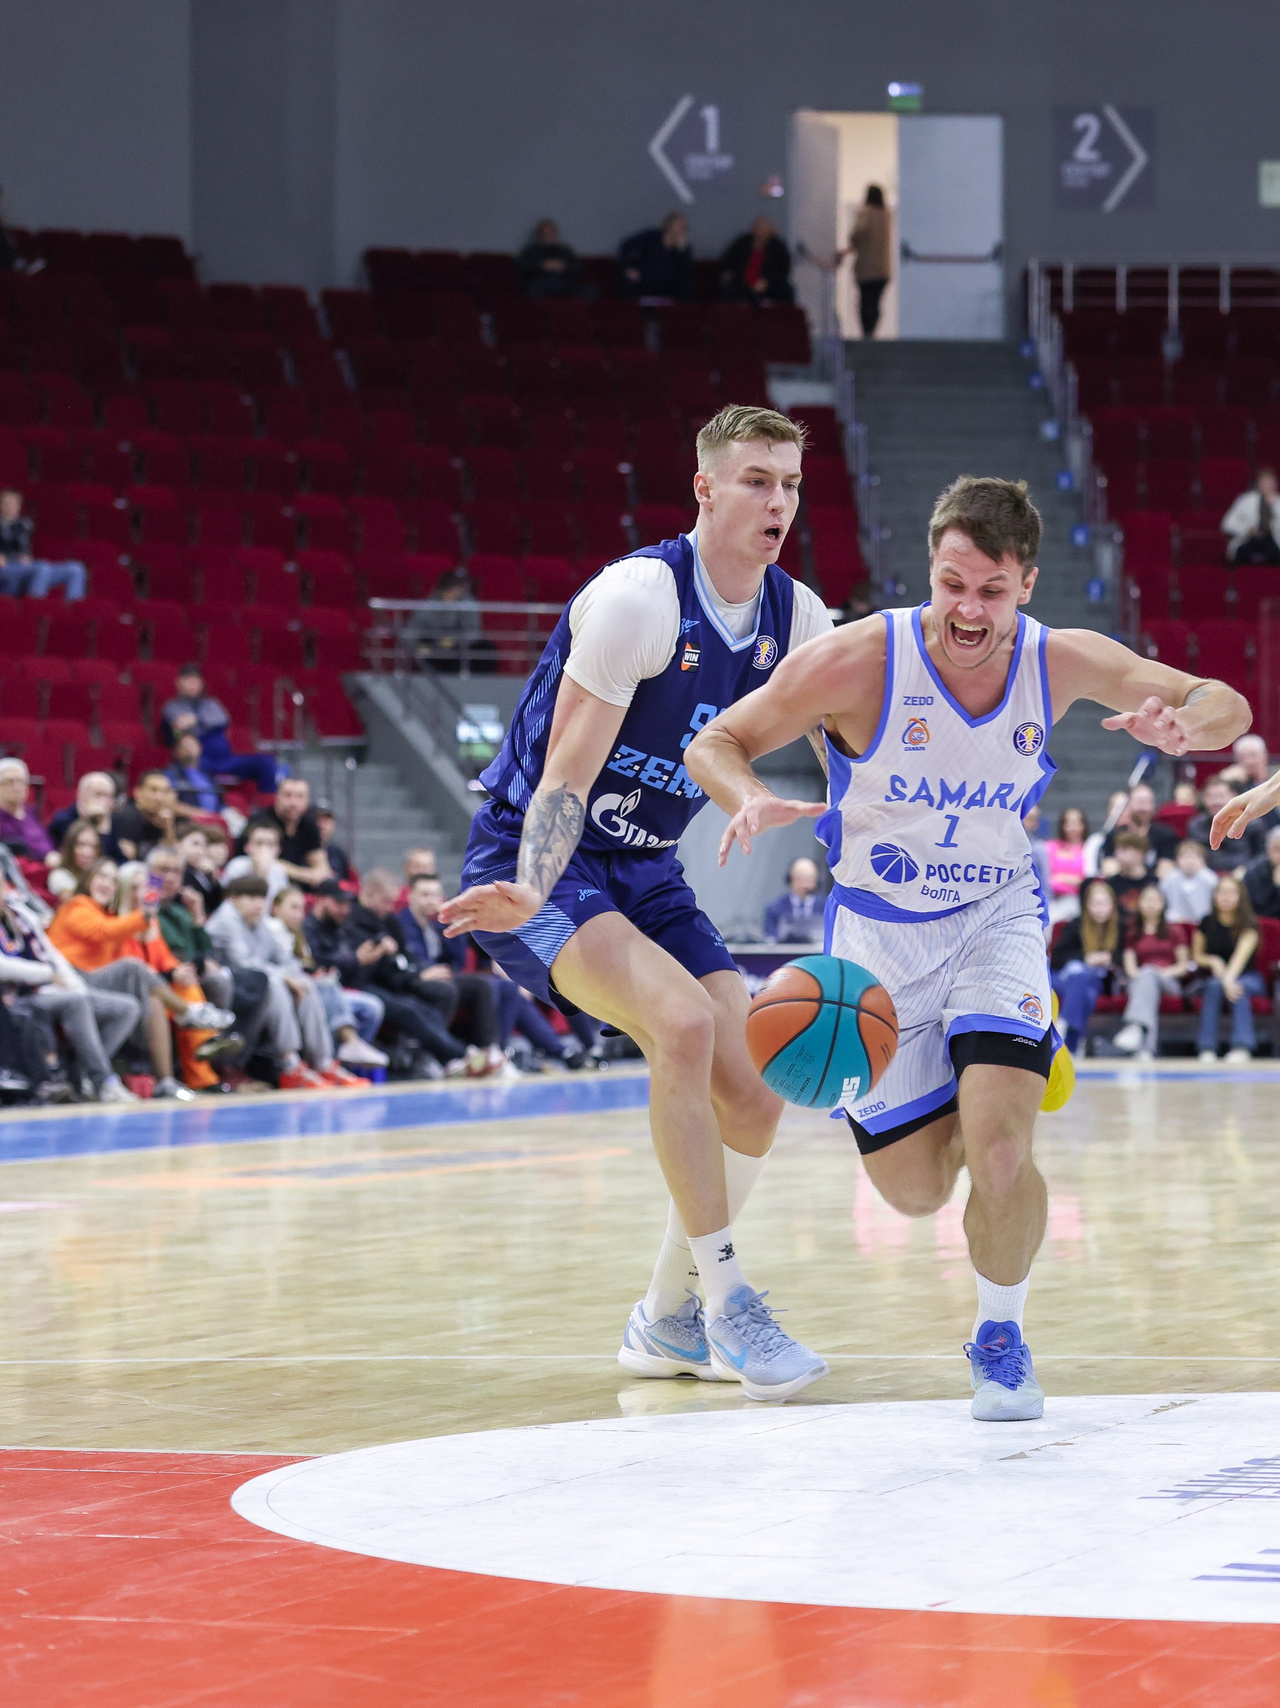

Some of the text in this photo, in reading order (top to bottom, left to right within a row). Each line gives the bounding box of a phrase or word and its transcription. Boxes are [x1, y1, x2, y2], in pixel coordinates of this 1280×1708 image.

[701, 105, 720, 153] 1
[1073, 113, 1100, 161] 2
[685, 652, 700, 663] WIN
[903, 696, 934, 706] ZEDO
[680, 703, 726, 749] 9
[935, 815, 960, 848] 1
[857, 1101, 886, 1117] ZEDO
